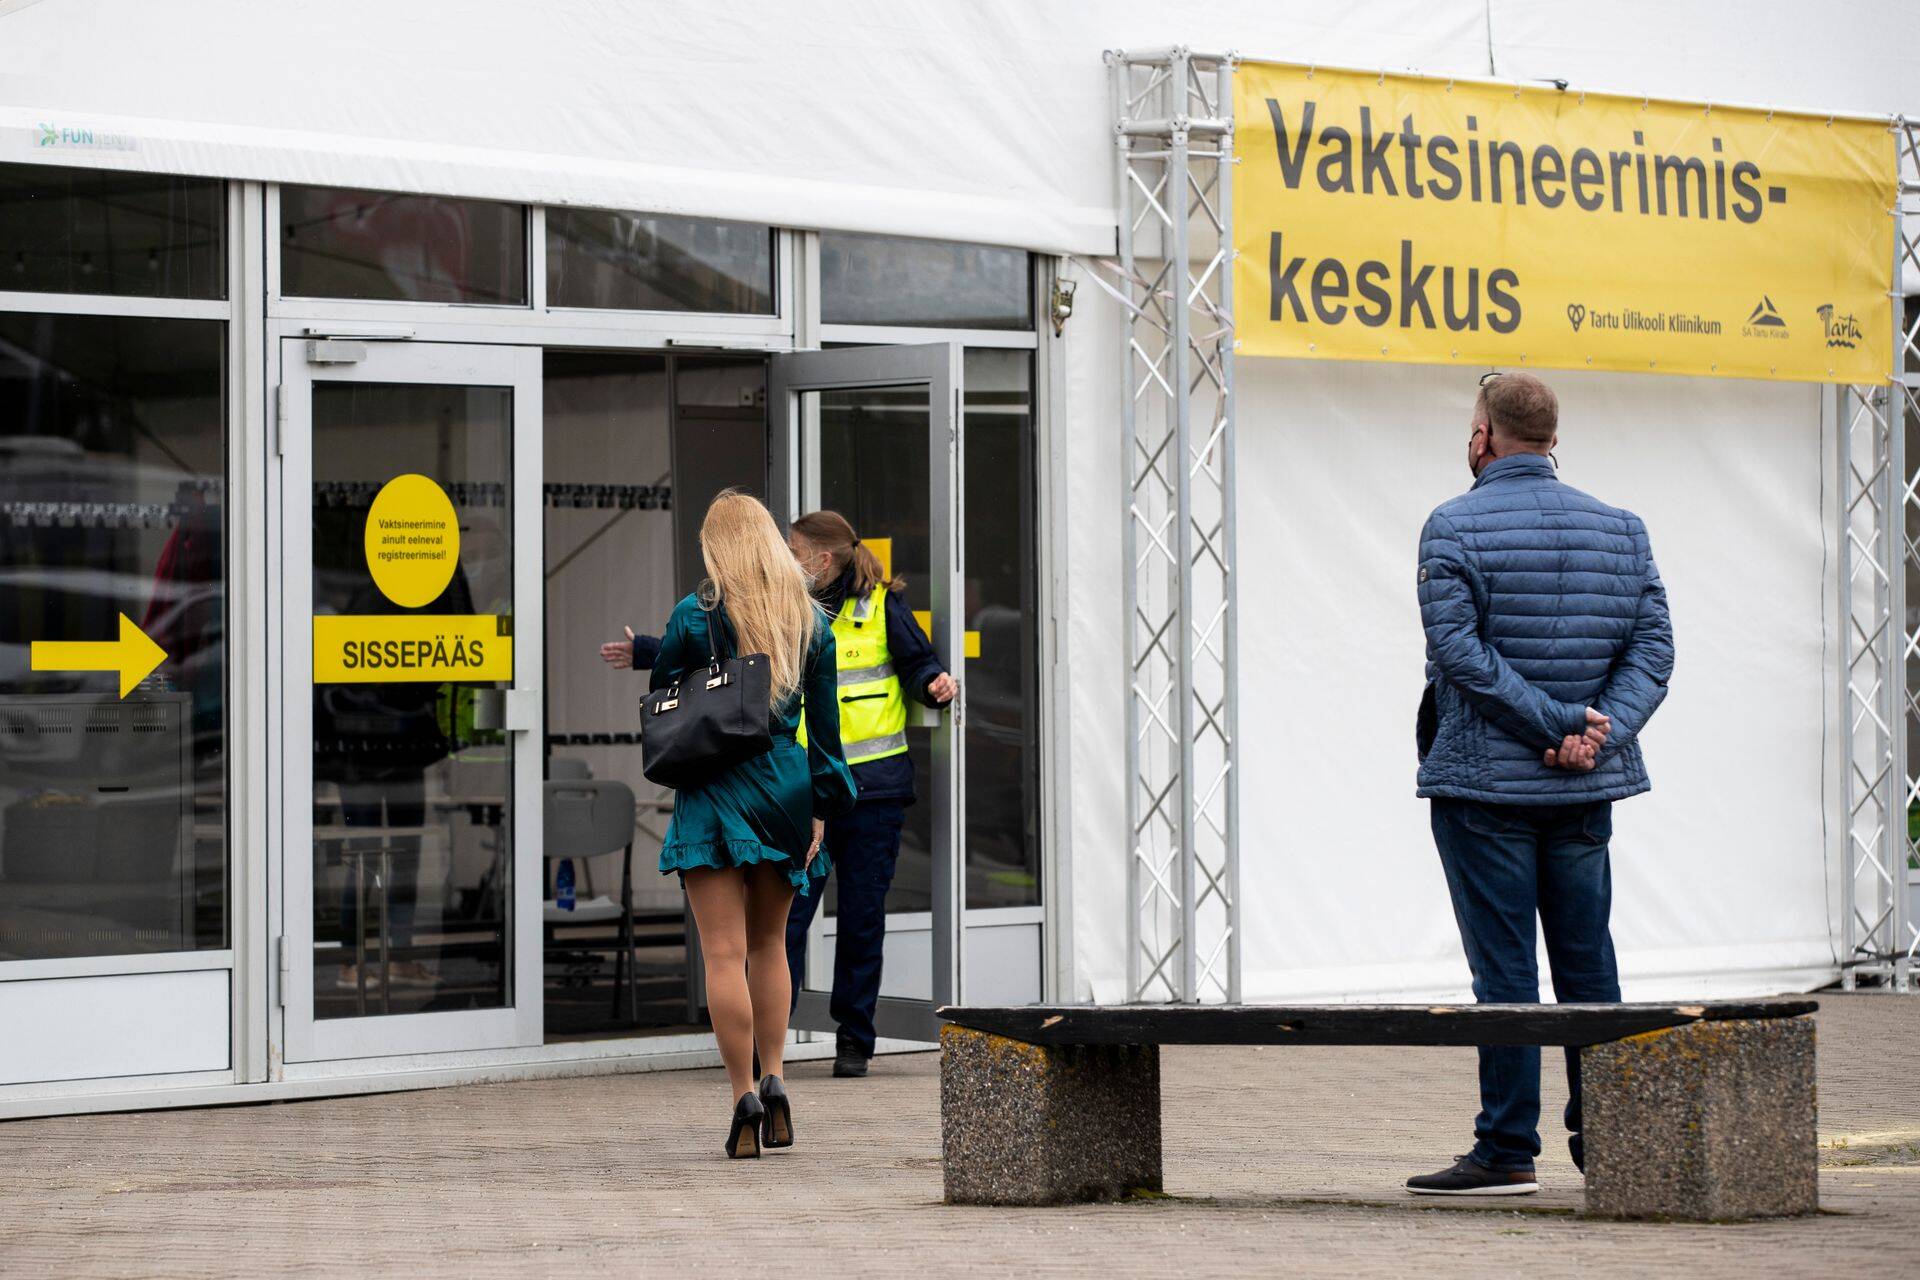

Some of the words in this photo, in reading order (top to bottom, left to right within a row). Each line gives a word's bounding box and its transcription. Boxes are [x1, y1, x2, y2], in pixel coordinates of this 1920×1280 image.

[1265, 98, 1786, 224] Vaktsineerimis-
[1268, 231, 1522, 334] keskus
[1590, 311, 1619, 329] Tartu
[1622, 309, 1665, 331] Ülikooli
[1668, 314, 1722, 334] Kliinikum
[1816, 304, 1863, 340] Tartu
[378, 519, 446, 529] Vaktsineerimine
[381, 535, 406, 545] ainult
[407, 535, 443, 545] eelneval
[378, 550, 447, 562] registreerimisel!
[342, 635, 484, 669] SISSEPÄÄS
